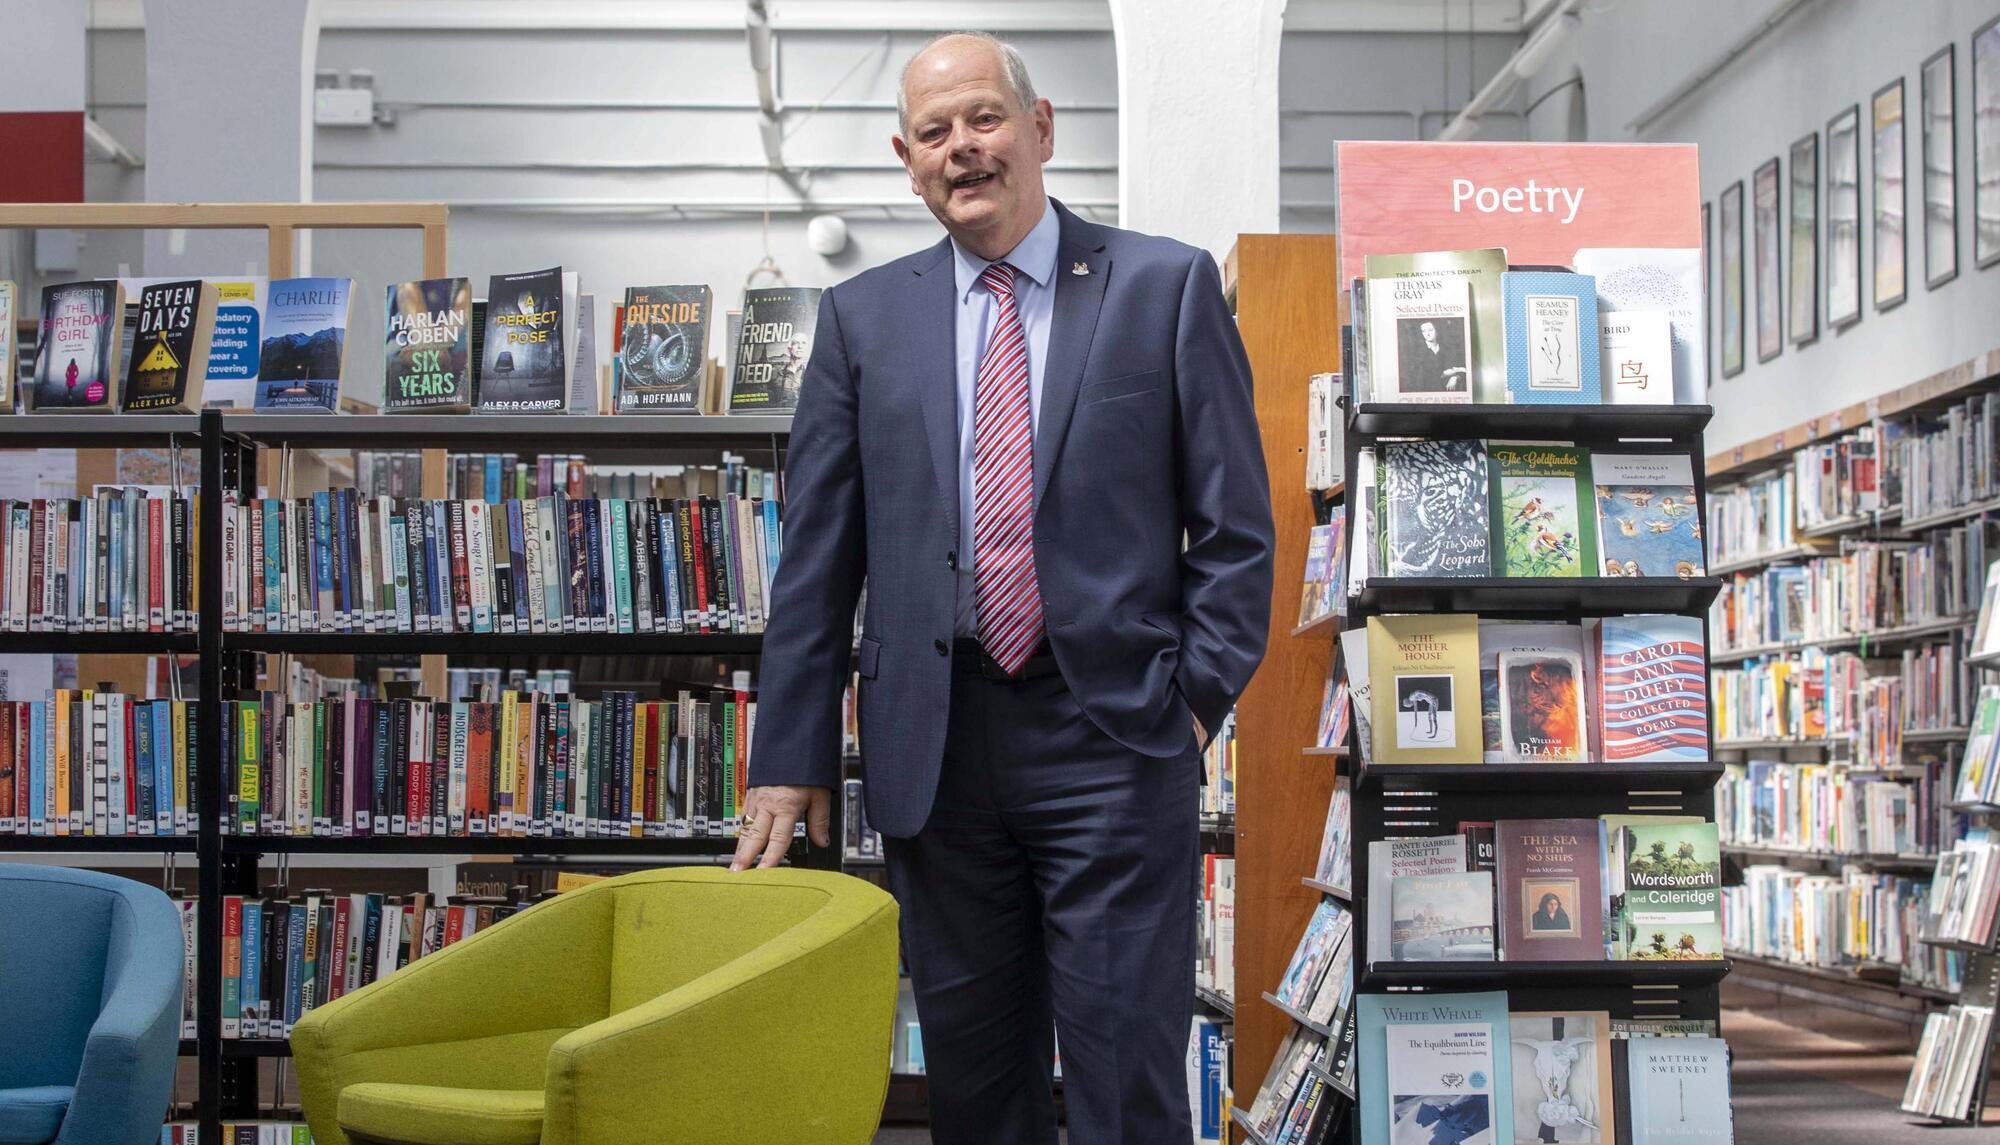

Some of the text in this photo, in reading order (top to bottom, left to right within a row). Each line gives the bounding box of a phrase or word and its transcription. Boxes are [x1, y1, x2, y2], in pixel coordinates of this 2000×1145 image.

[1452, 179, 1584, 224] Poetry
[52, 288, 104, 301] SUE FORTIN
[1395, 281, 1442, 290] THOMAS
[144, 287, 195, 309] SEVEN
[274, 290, 342, 307] CHARLIE
[524, 296, 535, 307] A
[1394, 290, 1425, 300] GRAY
[65, 303, 87, 313] THE
[627, 303, 700, 327] OUTSIDE
[745, 305, 754, 324] A
[1396, 303, 1463, 313] Selected Poems
[1535, 309, 1568, 317] HEANEY
[43, 314, 109, 329] BIRTHDAY
[140, 306, 192, 333] DAYS
[215, 313, 252, 324] ndatory
[390, 310, 464, 331] HARLAN
[495, 310, 557, 327] PERFECT
[57, 330, 90, 341] GIRL
[214, 326, 248, 335] itors to
[395, 326, 459, 347] COBEN
[508, 331, 547, 345] POSE
[741, 322, 793, 344] FRIEND
[1604, 326, 1631, 335] BIRD
[211, 339, 248, 349] uildings
[411, 349, 441, 373] SIX
[739, 344, 754, 364] IN
[208, 364, 248, 375] covering
[736, 364, 772, 385] DEED
[398, 373, 455, 397] YEARS
[129, 396, 177, 408] ALEX LAKE
[483, 400, 510, 409] ALEX
[521, 399, 561, 409] CARVER
[621, 392, 692, 405] ADA HOFFMANN
[408, 507, 416, 546] CONNELLY
[415, 509, 423, 543] MICHAEL
[452, 503, 464, 558] ROBIN COOK
[589, 513, 597, 549] CHRISTMAS
[680, 507, 692, 562] kjell ola dahl
[225, 527, 234, 562] END GAME
[253, 510, 264, 577] GETTING COLDER
[616, 505, 625, 571] OVERDRAWN
[1442, 534, 1486, 553] The Soho
[472, 530, 484, 576] Songs Us
[526, 539, 542, 576] Cornick
[636, 540, 646, 576] ABBEY
[1439, 549, 1486, 571] Leopard
[32, 563, 43, 577] TALE
[1398, 643, 1448, 652] MOTHER
[1413, 634, 1435, 643] THE
[1405, 652, 1442, 661] HOUSE
[1620, 642, 1687, 666] CAROL
[1633, 661, 1675, 683] ANN
[1624, 678, 1686, 703] DUFFY
[1619, 698, 1691, 720] COLLECTED
[1636, 718, 1677, 736] POEMS
[140, 732, 148, 753] BOX
[436, 714, 447, 779] SHADOW MAN
[454, 712, 466, 769] INDISCRETION
[1519, 742, 1573, 756] BLAKE
[375, 710, 389, 794] after the eclipse
[189, 747, 197, 777] WITNESS
[242, 766, 257, 800] PATSY
[1391, 838, 1458, 850] DANTE GABRIEL
[1520, 835, 1578, 846] THE SEA
[1391, 847, 1440, 859] ROSSETTI
[1478, 843, 1493, 858] CO
[1527, 854, 1574, 862] NO SHIPS
[1535, 846, 1563, 854] WITH
[1391, 857, 1457, 868] Selected Poems
[1403, 866, 1456, 876] Translations
[1631, 872, 1714, 886] Wordsworth
[1631, 890, 1714, 905] and Coleridge
[307, 910, 315, 957] TELEPHONE
[247, 910, 256, 979] Finding Alison
[334, 923, 345, 976] MERCURY FOUNTAIN
[1382, 1007, 1483, 1021] WHITE WHALE
[1663, 1024, 1705, 1032] CONQUEST
[1408, 1039, 1487, 1051] The Equilibrium Line
